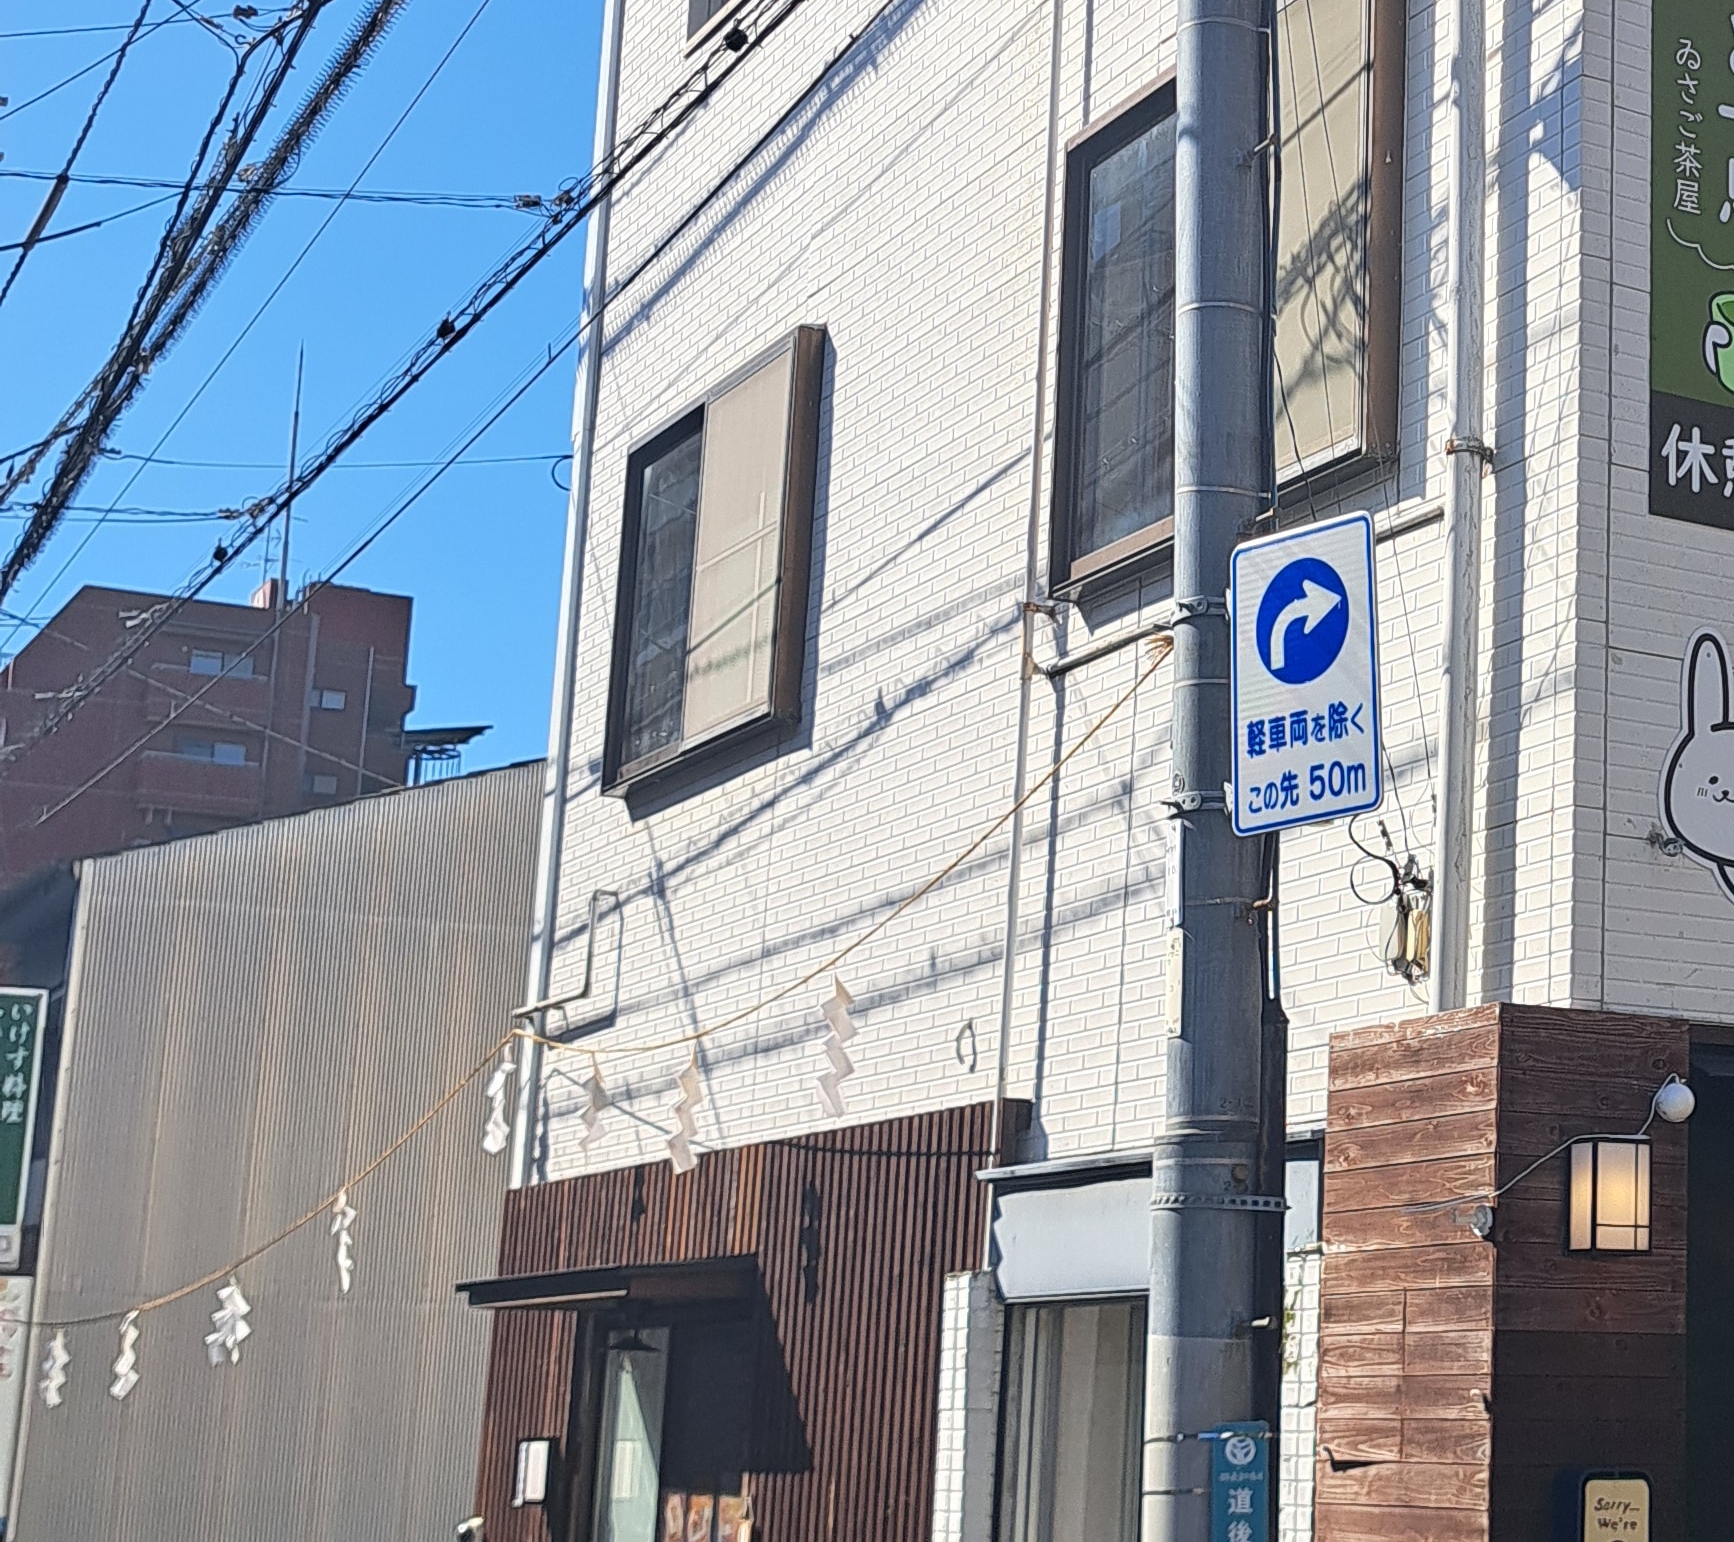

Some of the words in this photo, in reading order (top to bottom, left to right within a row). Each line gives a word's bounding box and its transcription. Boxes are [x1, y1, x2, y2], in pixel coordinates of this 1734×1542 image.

[1246, 701, 1364, 759] 軽車両を除く
[1248, 769, 1299, 814] この先
[1309, 760, 1366, 801] 50m
[1597, 1517, 1638, 1532] We're
